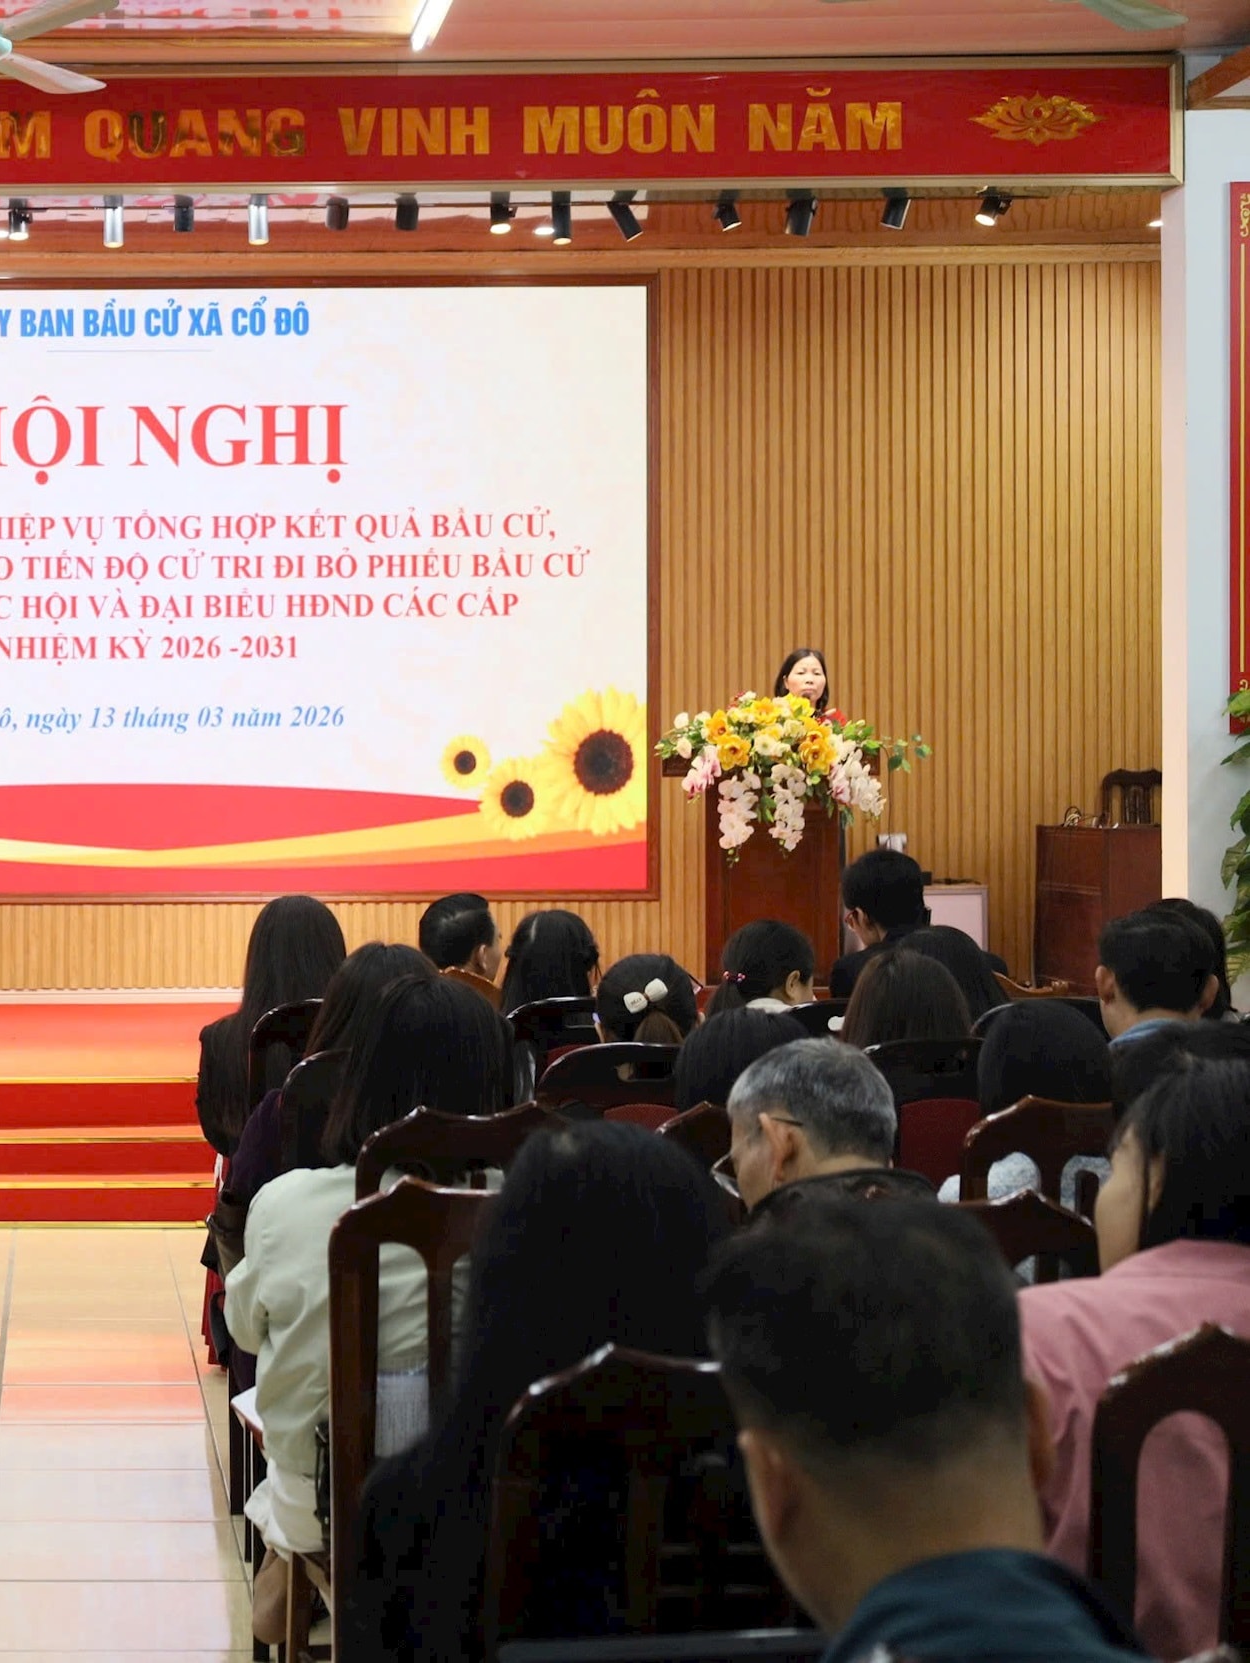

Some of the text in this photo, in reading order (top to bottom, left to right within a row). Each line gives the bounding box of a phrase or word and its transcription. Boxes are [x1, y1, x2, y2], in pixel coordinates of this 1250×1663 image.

[83, 108, 307, 163] QUANG
[338, 105, 490, 156] VINH
[522, 88, 717, 156] MUÔN
[748, 86, 904, 154] NĂM
[20, 308, 74, 338] BAN
[83, 298, 136, 338] BẦU
[144, 297, 183, 338] CỬ
[188, 301, 224, 337] XÃ
[231, 295, 267, 337] CỔ
[274, 301, 310, 337] ĐÔ
[128, 403, 348, 485] NGHỊ
[62, 515, 105, 547] VỤ
[113, 508, 202, 541] TỔNG
[211, 513, 277, 547] HỢP
[284, 507, 347, 540] KẾT
[354, 507, 422, 544] QUẢ
[431, 508, 494, 539] BẦU
[502, 505, 557, 541] CỬ,
[21, 549, 95, 581] TIẾN
[104, 553, 149, 586] ĐỘ
[157, 548, 205, 581] CỬ
[210, 554, 264, 580] TRI
[273, 554, 305, 579] ĐI
[315, 547, 359, 579] BỎ
[367, 546, 462, 579] PHIẾU
[471, 547, 533, 578] BẦU
[542, 545, 591, 578] CỬ
[21, 593, 79, 626] HỘI
[86, 588, 130, 620] VÀ
[140, 594, 193, 625] ĐẠI
[203, 587, 276, 619] BIỂU
[285, 593, 376, 618] HĐND
[382, 587, 449, 618] CÁC
[456, 586, 520, 618] CẤP
[108, 629, 152, 660] KỲ
[160, 635, 222, 660] 2026
[229, 635, 298, 659] -2031
[25, 706, 82, 735] ngày
[90, 706, 117, 729] 13
[122, 706, 190, 734] tháng
[196, 706, 225, 729] 03
[231, 706, 283, 729] năm
[289, 705, 346, 729] 2026
